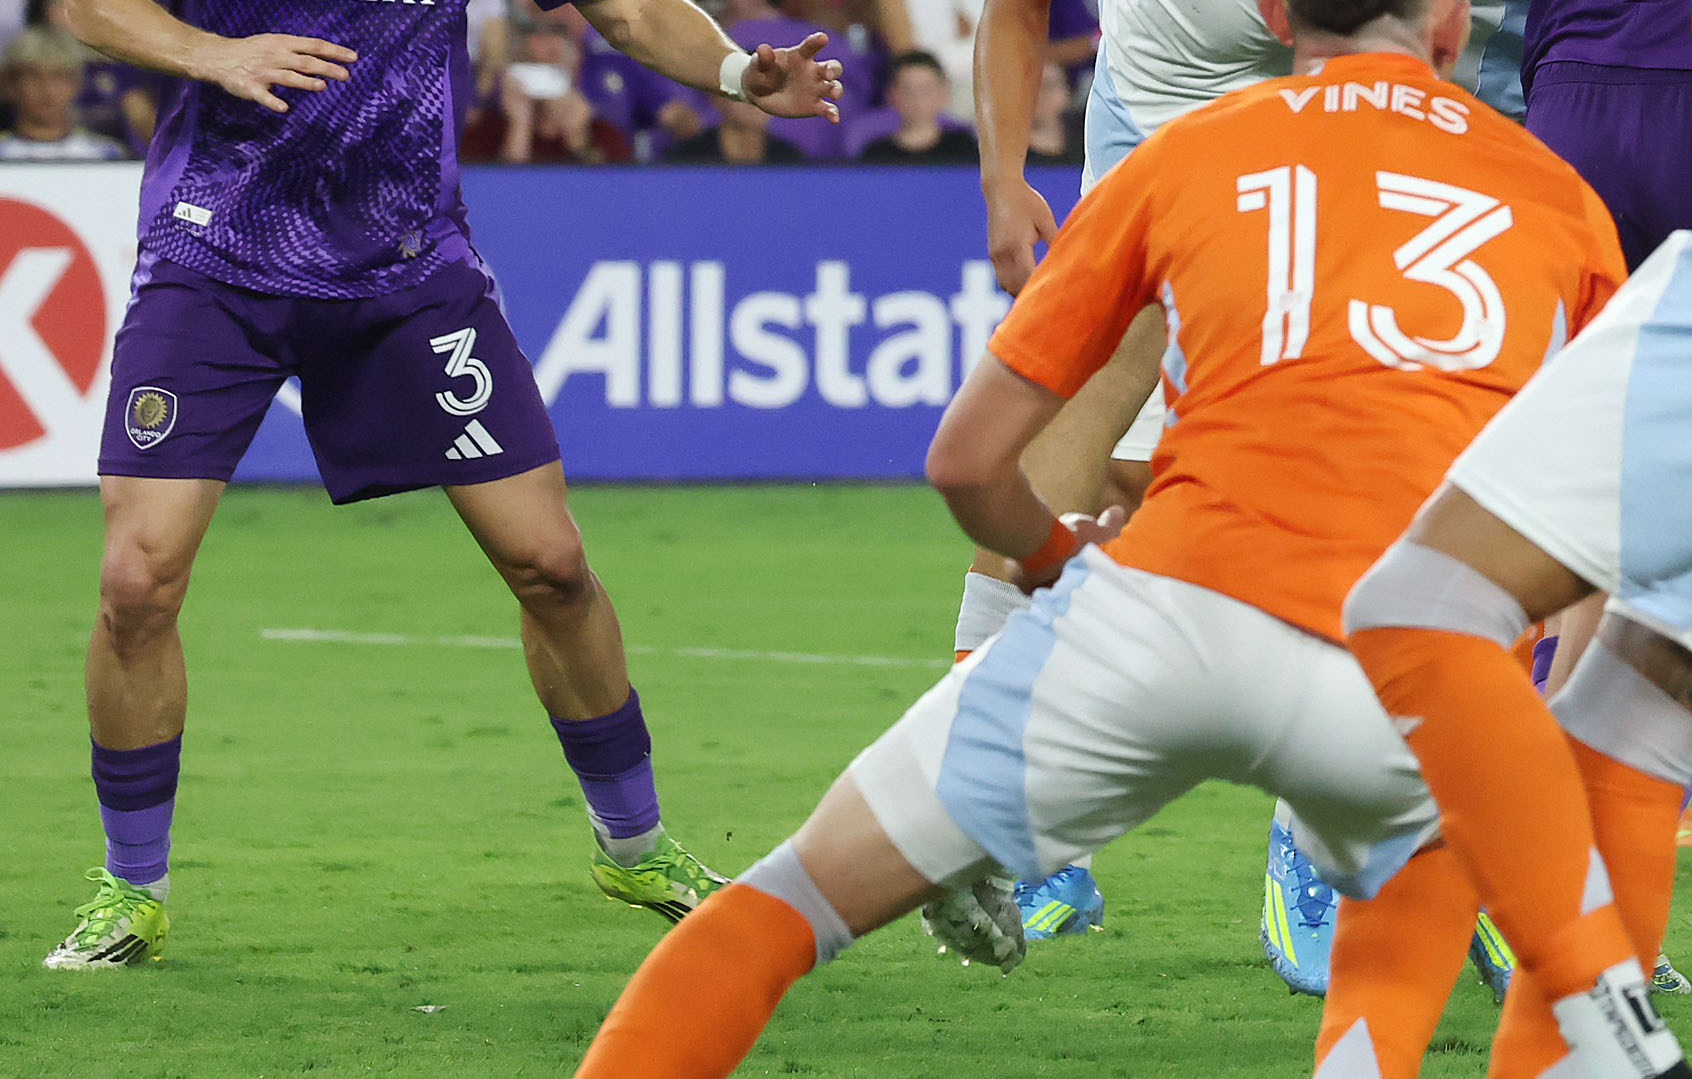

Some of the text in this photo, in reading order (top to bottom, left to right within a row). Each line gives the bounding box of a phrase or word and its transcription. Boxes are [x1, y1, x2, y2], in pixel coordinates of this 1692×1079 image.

[1279, 81, 1471, 135] VINES
[1236, 164, 1514, 372] 13
[429, 327, 493, 416] 3
[533, 260, 1014, 408] Allstat
